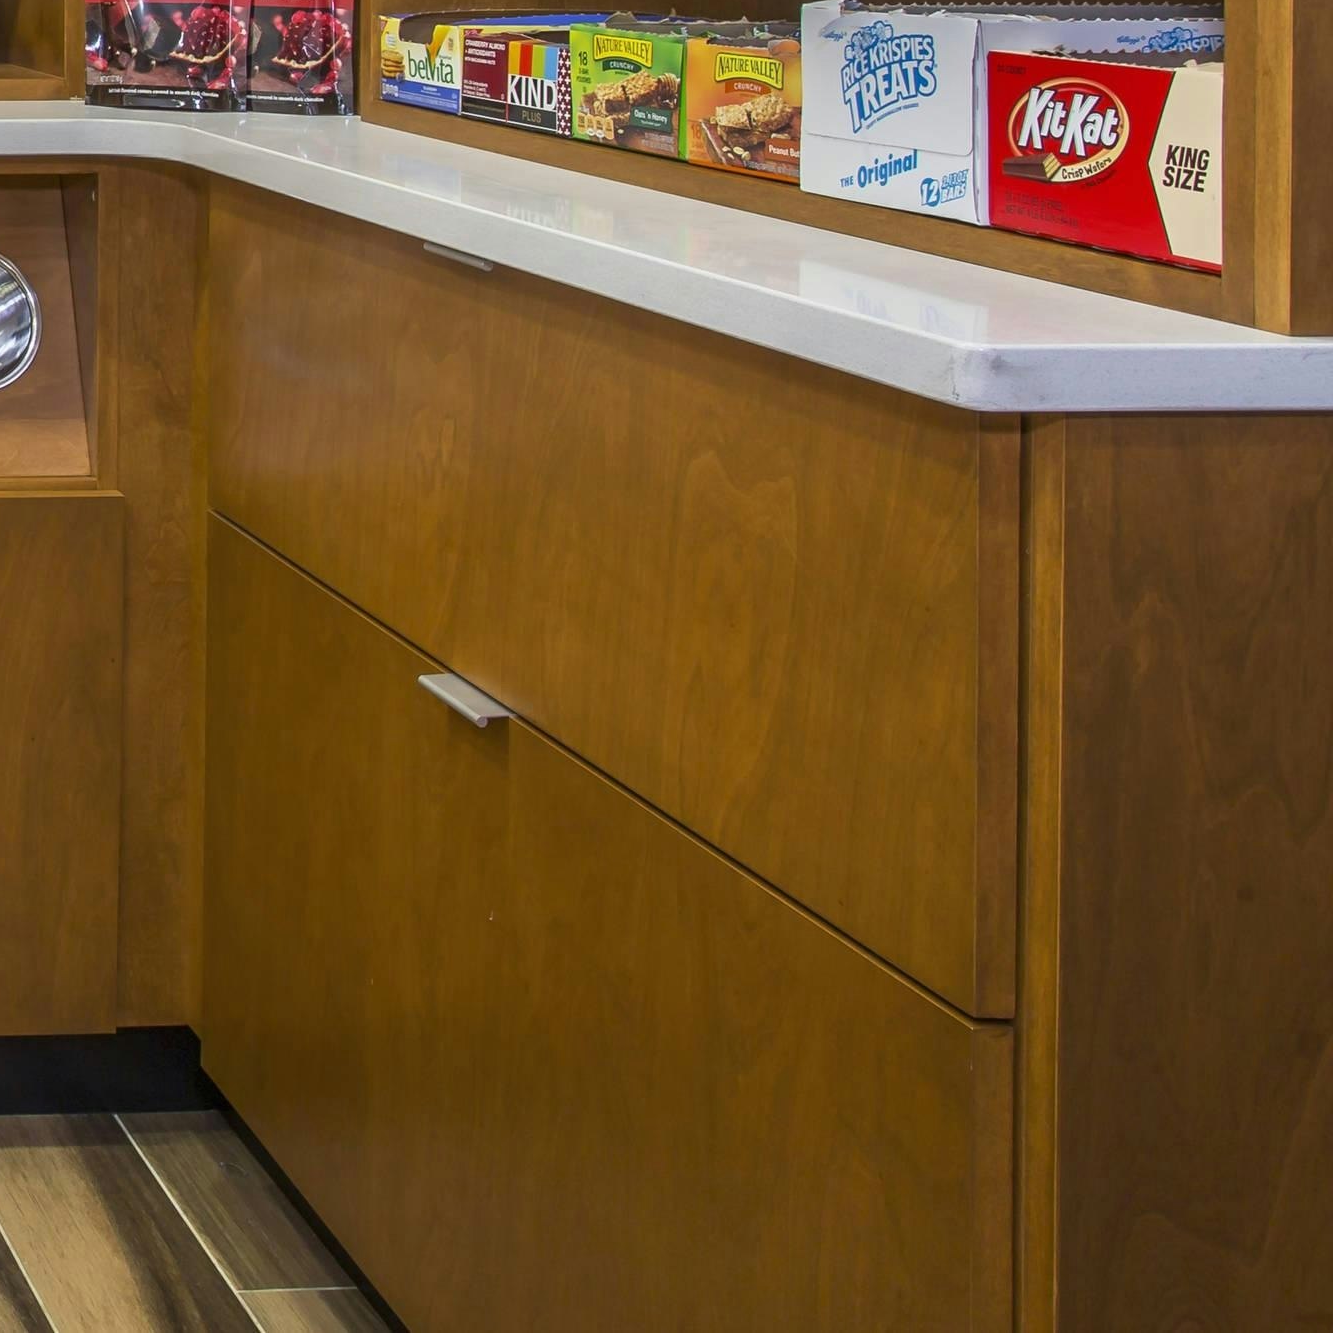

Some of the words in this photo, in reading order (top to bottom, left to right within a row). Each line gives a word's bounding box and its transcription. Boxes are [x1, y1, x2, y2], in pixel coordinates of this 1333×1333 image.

[578, 51, 588, 66] 18
[595, 36, 623, 56] NATURE
[622, 38, 651, 65] VALLEY
[869, 37, 933, 69] KRISPIES
[407, 50, 454, 84] belvita
[717, 58, 749, 77] NATURE
[749, 61, 781, 85] VALLEY
[508, 74, 556, 111] KIND
[734, 82, 762, 93] CRUNCHY
[844, 60, 937, 133] TREATS
[521, 110, 541, 123] PLUS
[768, 144, 789, 156] Peanut
[1166, 145, 1210, 171] KING
[841, 176, 854, 188] THE
[857, 149, 918, 188] Original
[1163, 167, 1206, 192] SIZE
